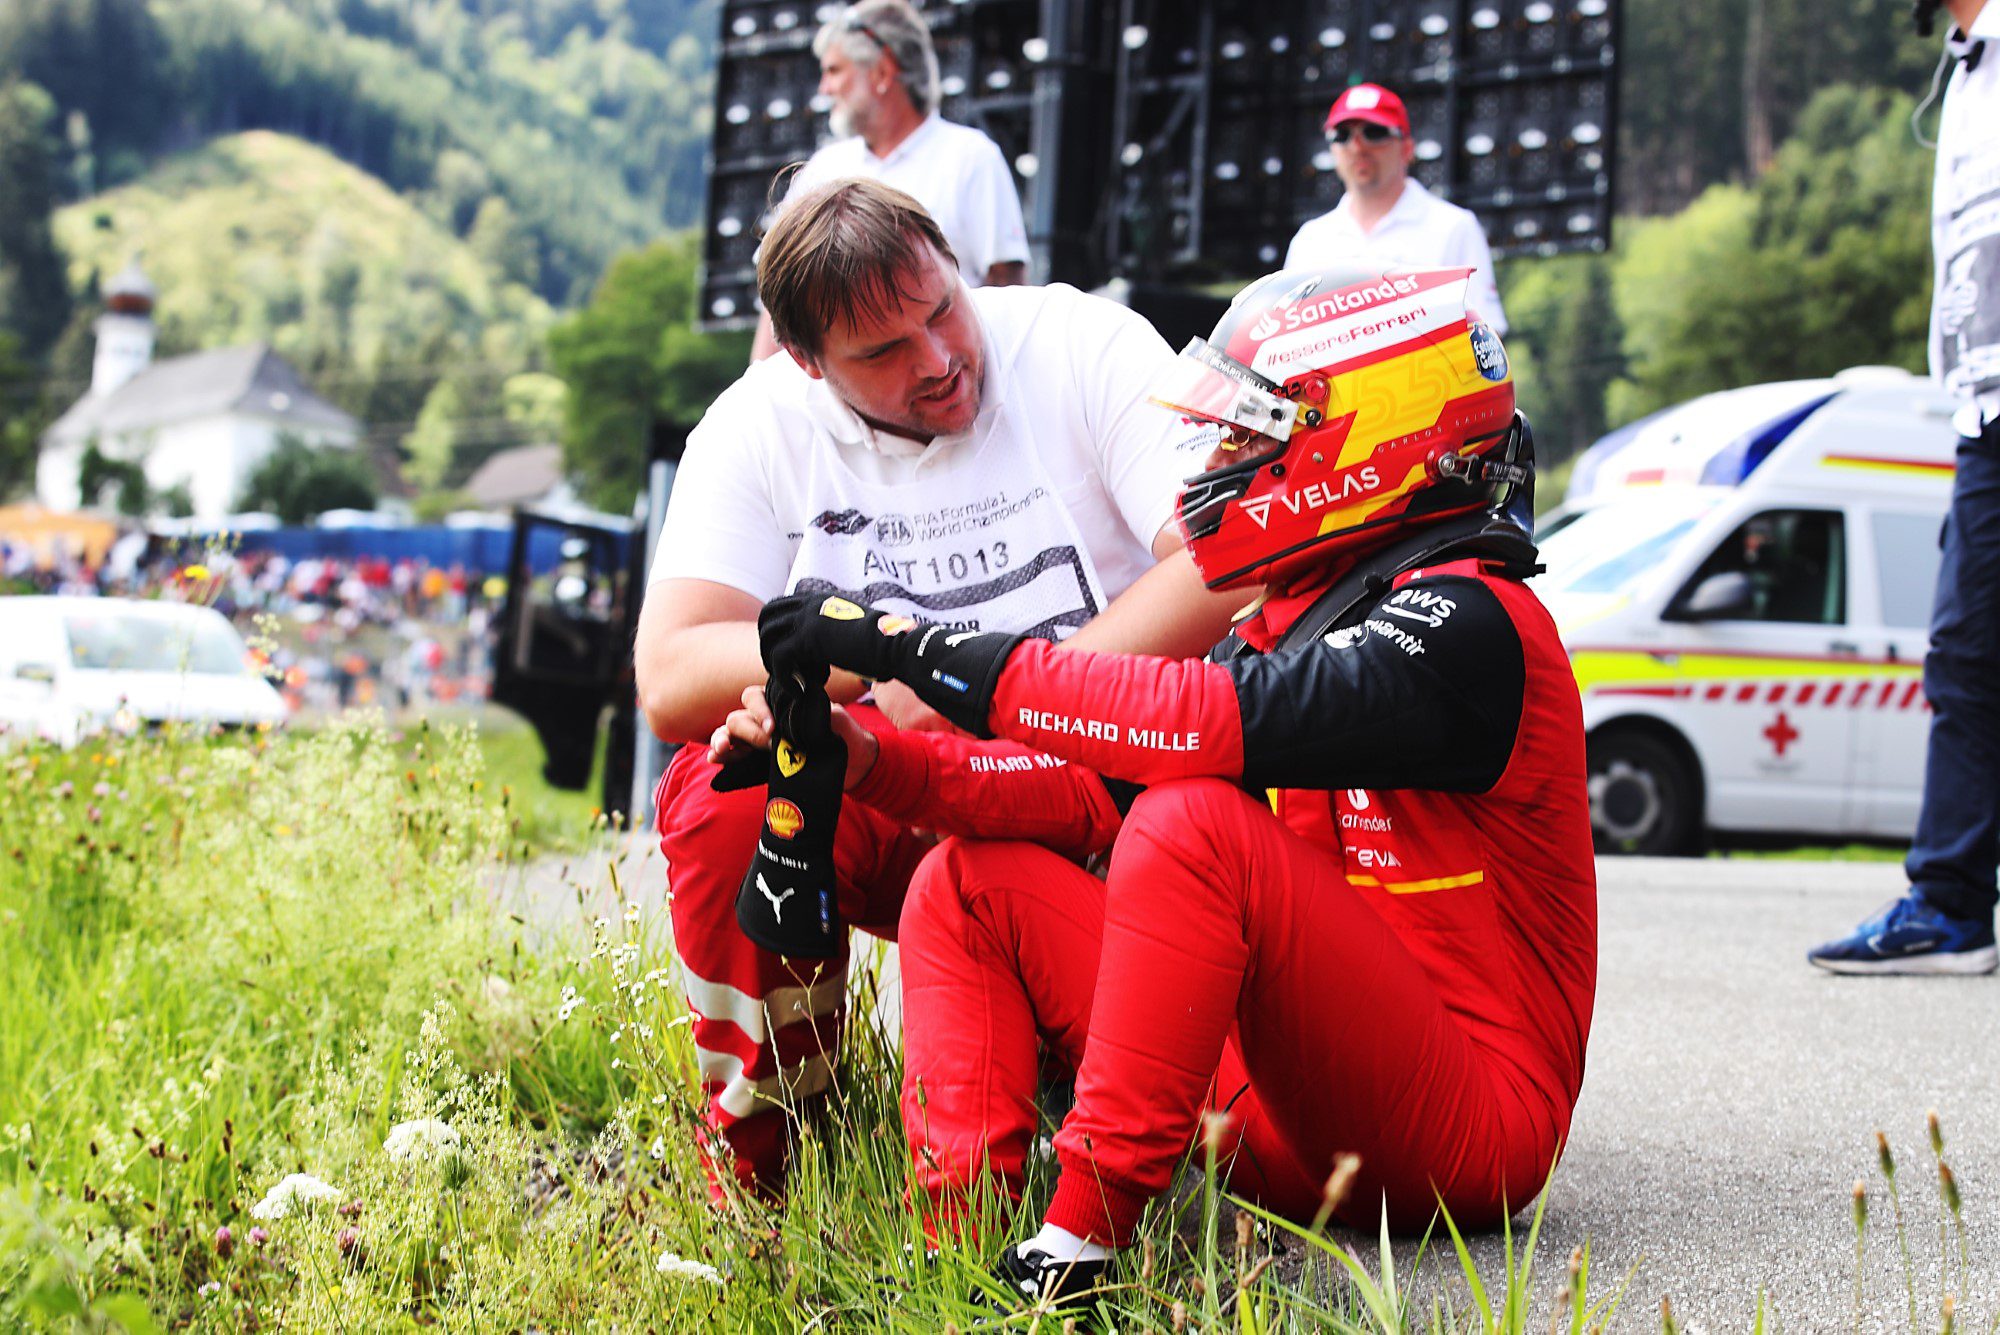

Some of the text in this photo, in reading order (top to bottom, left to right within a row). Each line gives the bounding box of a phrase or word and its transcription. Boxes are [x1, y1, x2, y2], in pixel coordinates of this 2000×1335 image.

[1286, 275, 1419, 330] Santander
[1377, 409, 1495, 453] CARLOS SAINZ
[1282, 465, 1381, 516] VELAS
[877, 518, 911, 542] FIA
[914, 512, 938, 527] FIA
[940, 496, 998, 522] Formula
[918, 520, 961, 541] World
[1391, 589, 1457, 618] aws
[1018, 707, 1200, 752] RICHARD MILLE
